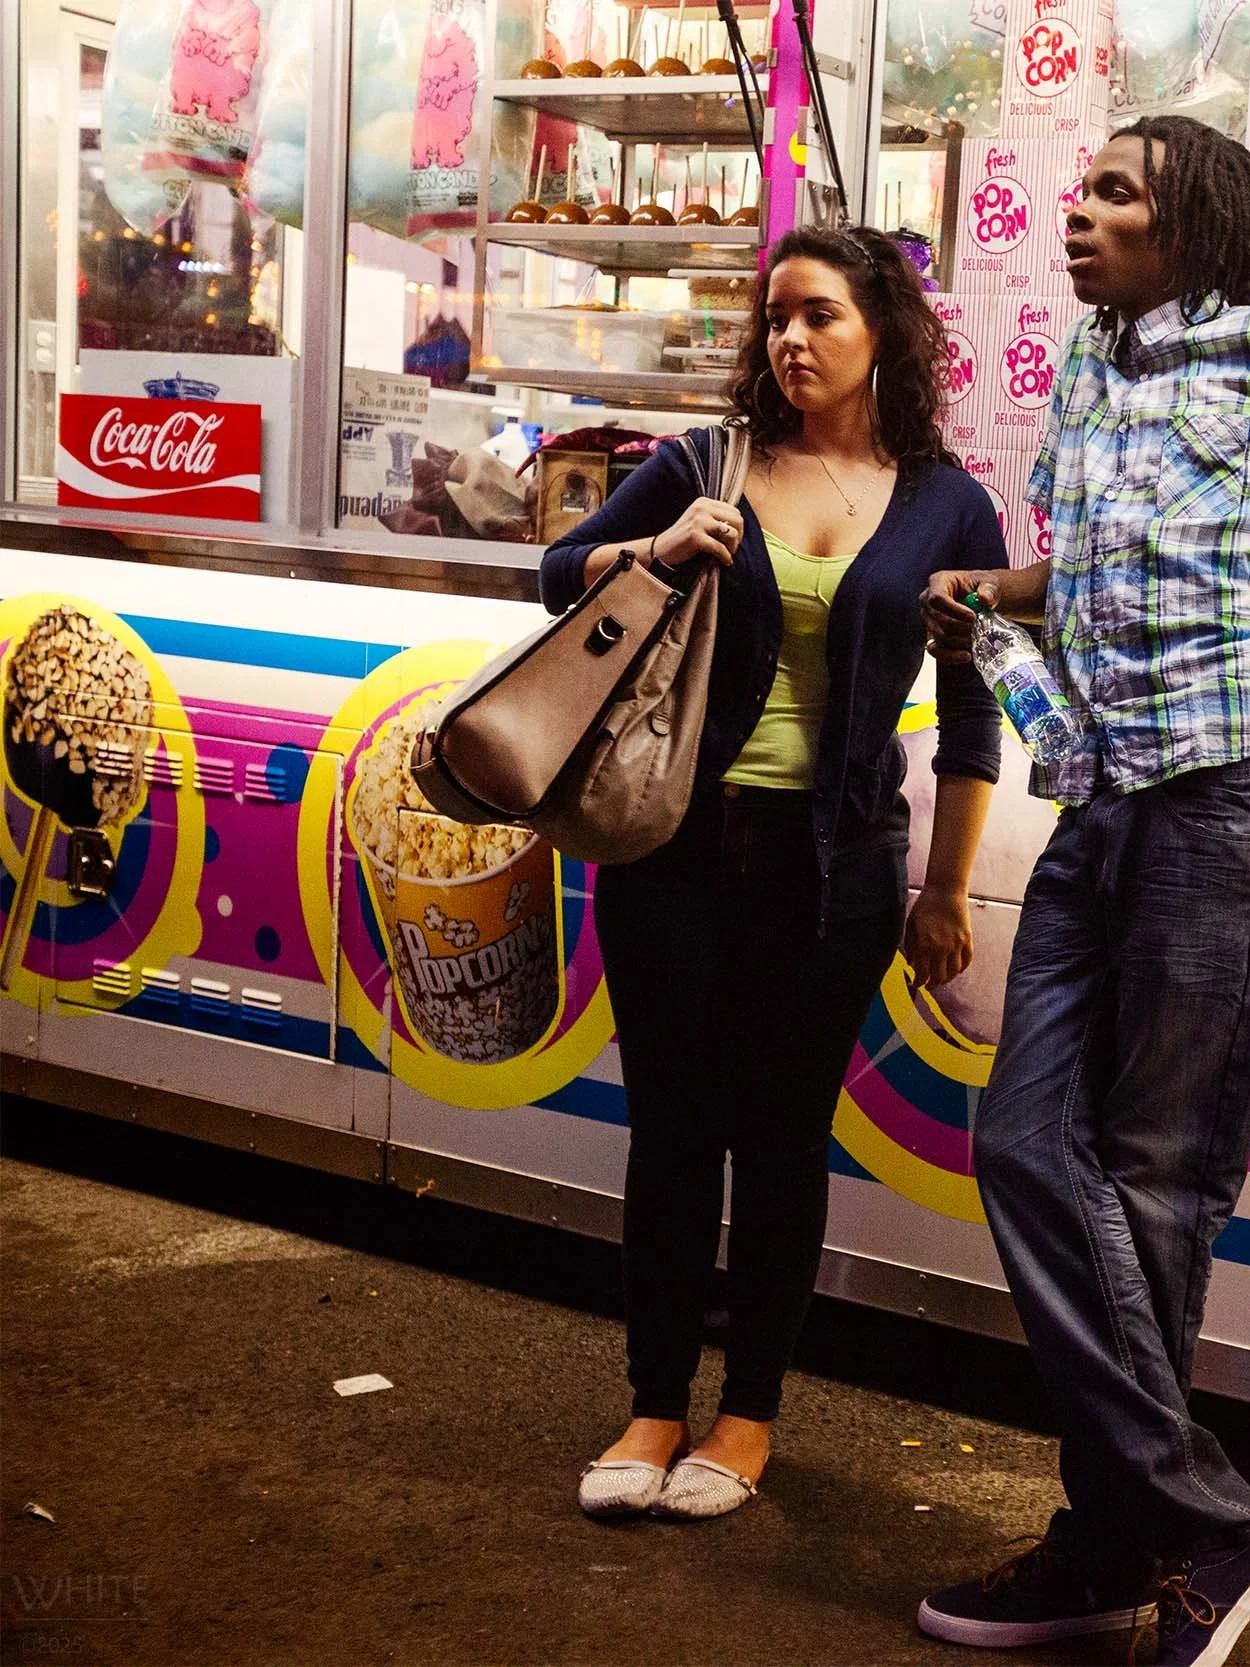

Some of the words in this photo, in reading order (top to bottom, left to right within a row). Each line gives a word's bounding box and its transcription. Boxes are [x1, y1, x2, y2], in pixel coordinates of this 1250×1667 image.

[1022, 26, 1063, 62] POP
[1026, 47, 1076, 86] CORN
[1009, 102, 1053, 116] DELICIOUS
[1054, 118, 1080, 133] CRISP
[985, 147, 1016, 177] fresh
[973, 183, 1013, 219] POP
[976, 205, 1027, 243] CORN
[962, 258, 1004, 272] DELICIOUS
[1006, 275, 1030, 288] CRISP
[1018, 303, 1049, 333] fresh
[1006, 339, 1047, 374] POP
[952, 425, 976, 440] CRISP
[994, 412, 1037, 428] DELICIOUS
[89, 407, 225, 475] Coca-Cola
